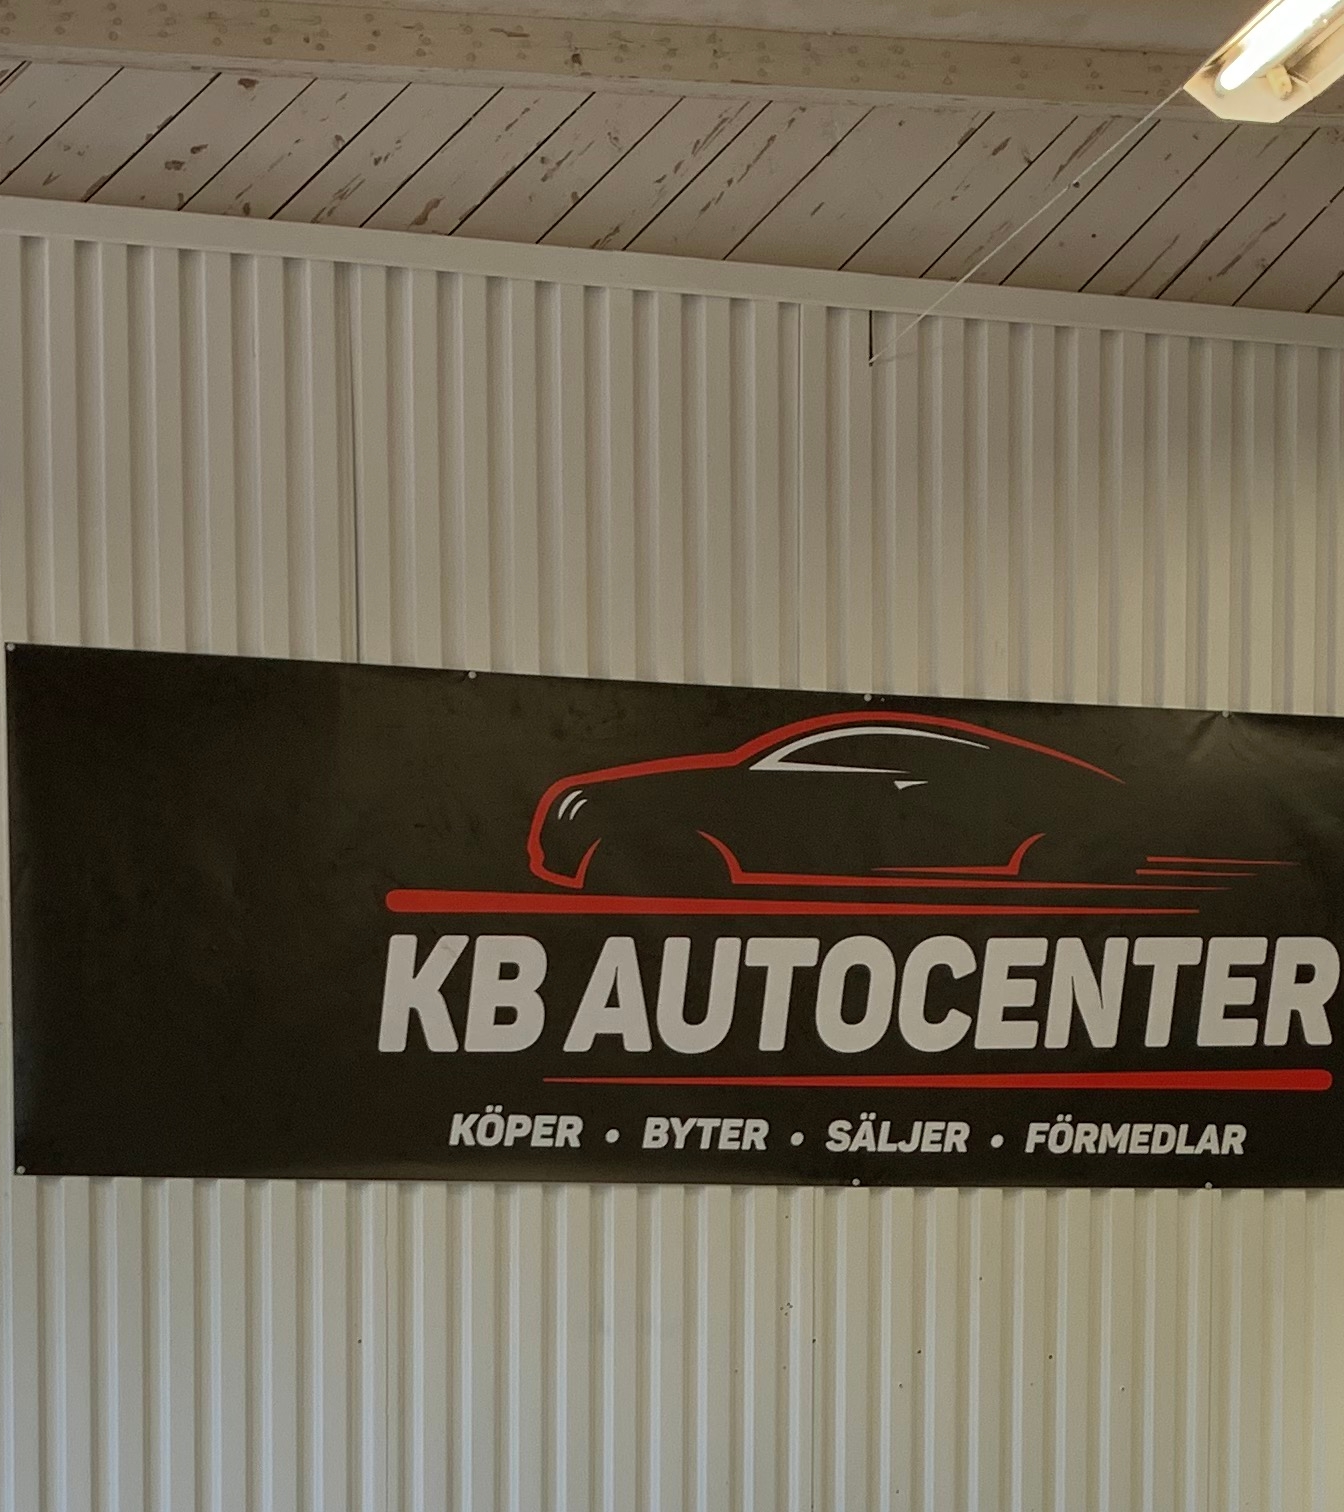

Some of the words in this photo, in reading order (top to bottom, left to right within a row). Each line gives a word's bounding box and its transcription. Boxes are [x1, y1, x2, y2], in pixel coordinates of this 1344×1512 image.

[378, 934, 548, 1054] KB
[562, 935, 1341, 1055] AUTOCENTER
[448, 1104, 584, 1148] KÖPER
[641, 1115, 770, 1151] BYTER
[825, 1111, 970, 1154] SÄLJER
[1024, 1113, 1247, 1155] FÖRMEDLAR
